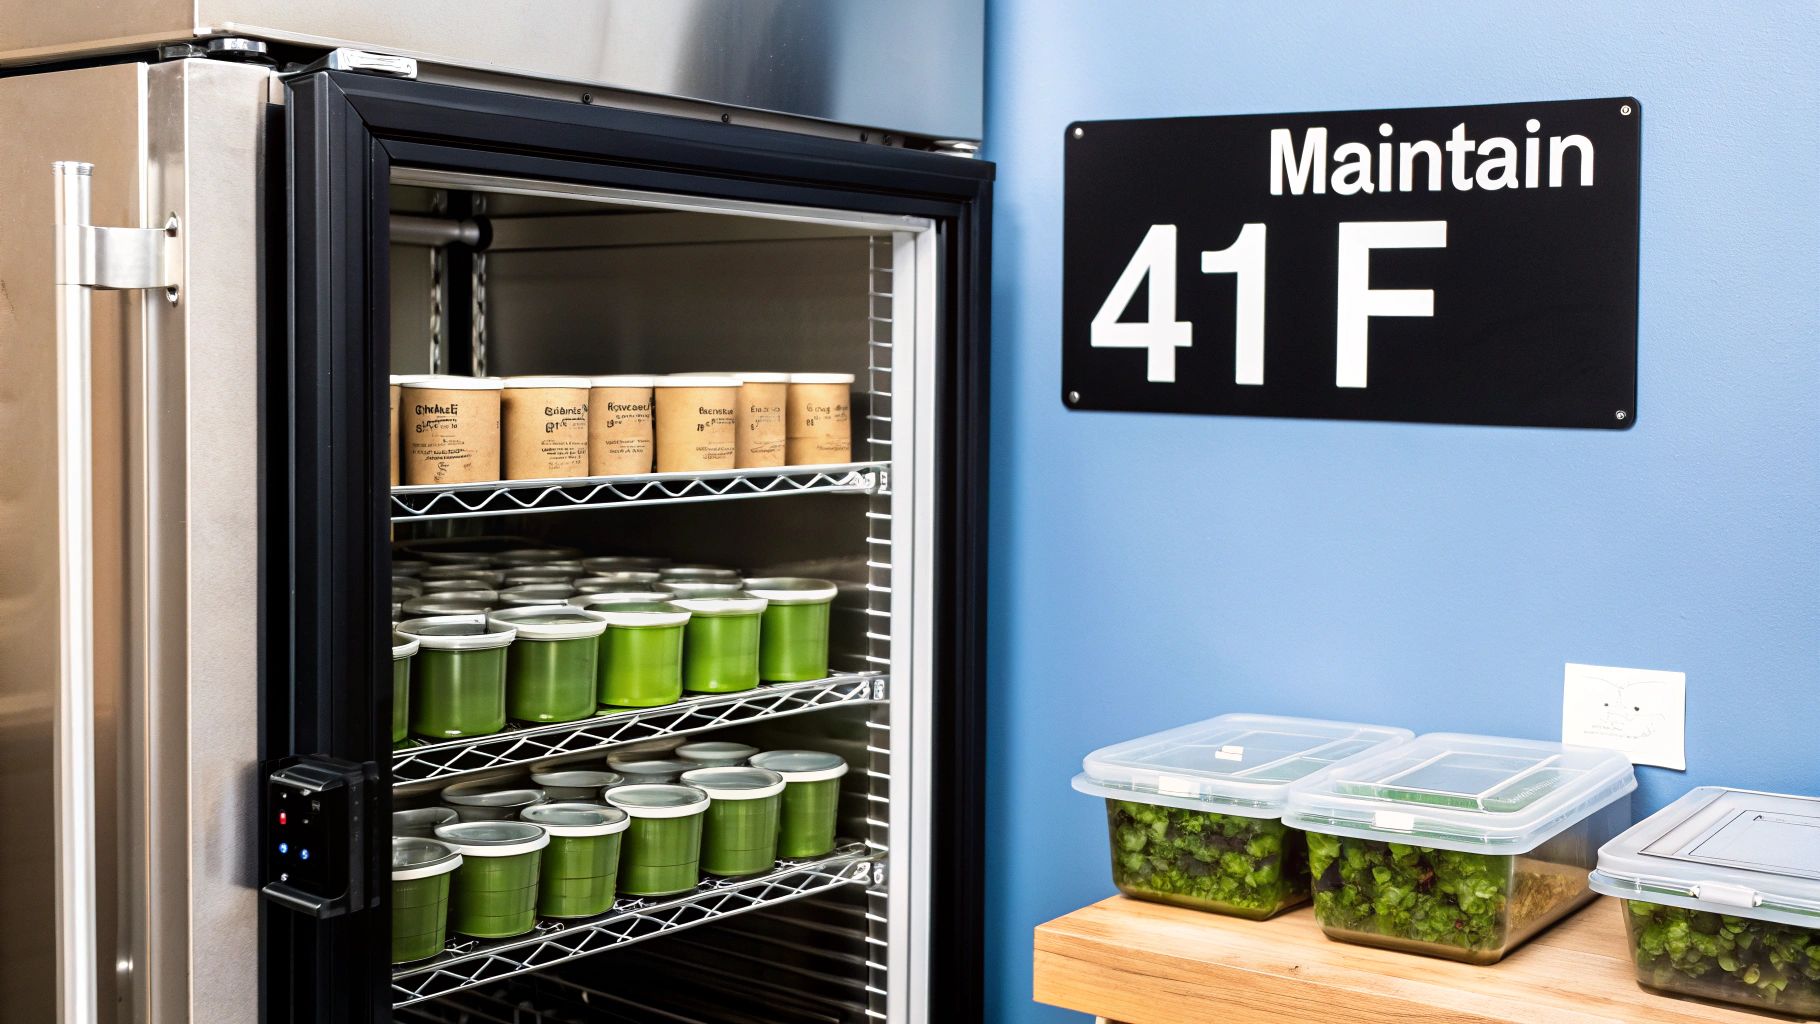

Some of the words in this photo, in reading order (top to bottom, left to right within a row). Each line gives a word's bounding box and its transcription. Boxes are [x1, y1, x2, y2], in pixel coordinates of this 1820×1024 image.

[1269, 118, 1596, 196] Maintain
[1090, 222, 1267, 386] 41
[1335, 220, 1448, 389] F
